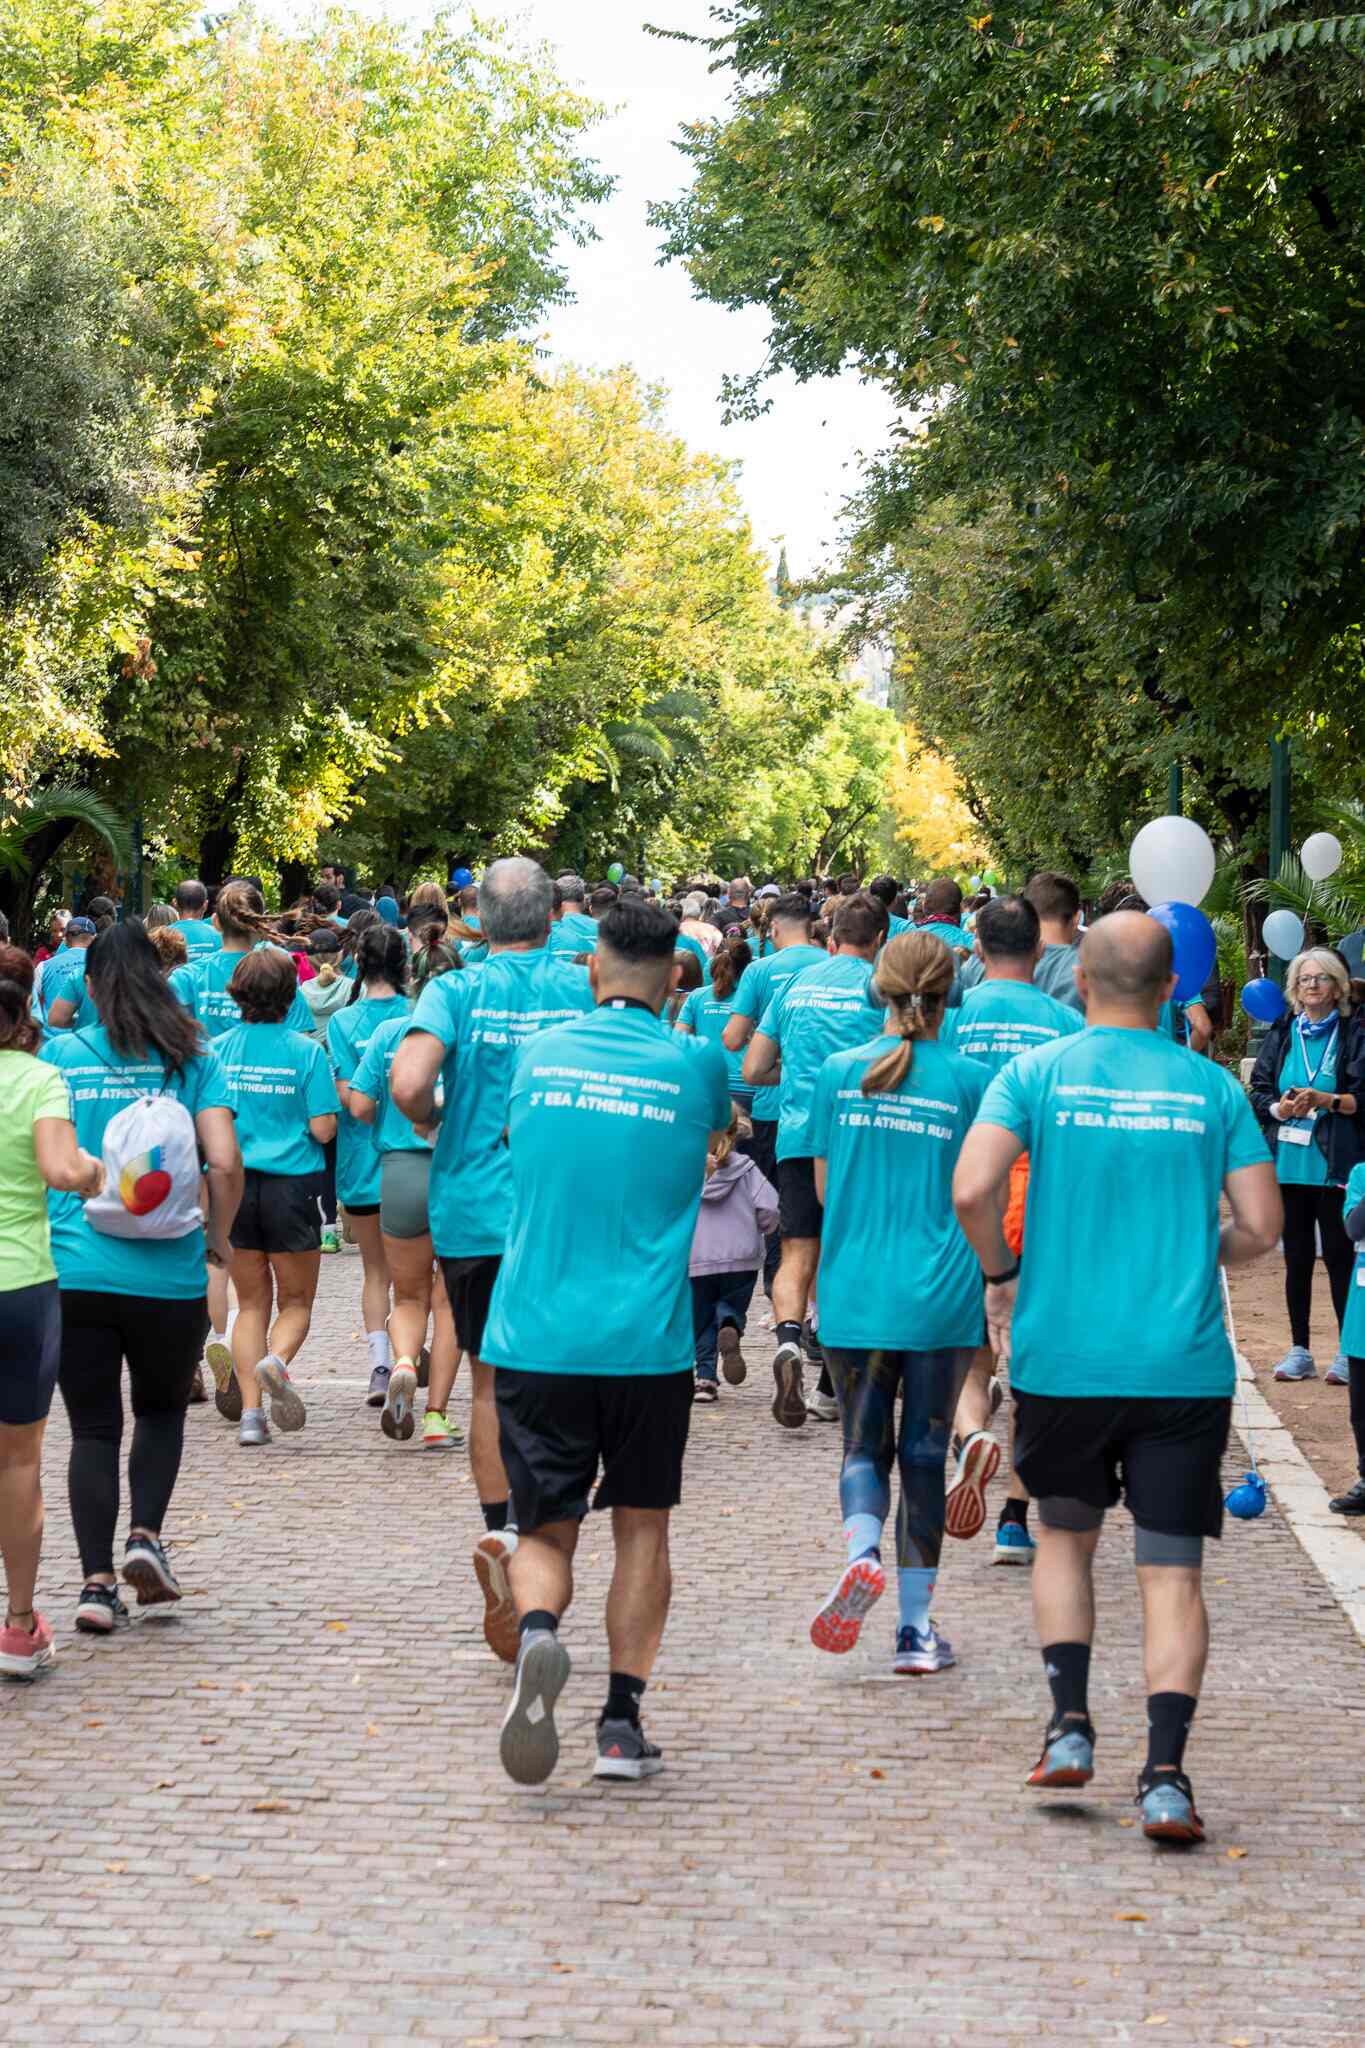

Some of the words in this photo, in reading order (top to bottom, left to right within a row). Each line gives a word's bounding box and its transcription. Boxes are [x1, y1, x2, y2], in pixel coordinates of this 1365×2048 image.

[275, 1085, 296, 1095] RUN
[544, 1091, 572, 1106] EEA
[575, 1095, 639, 1117] ATHENS
[642, 1104, 676, 1123] RUN
[848, 1113, 871, 1126] EEA
[873, 1115, 925, 1134] ATHENS
[927, 1123, 953, 1140] RUN
[1073, 1111, 1105, 1127] EEA
[1107, 1114, 1171, 1131] ATHENS
[1172, 1117, 1206, 1135] RUN
